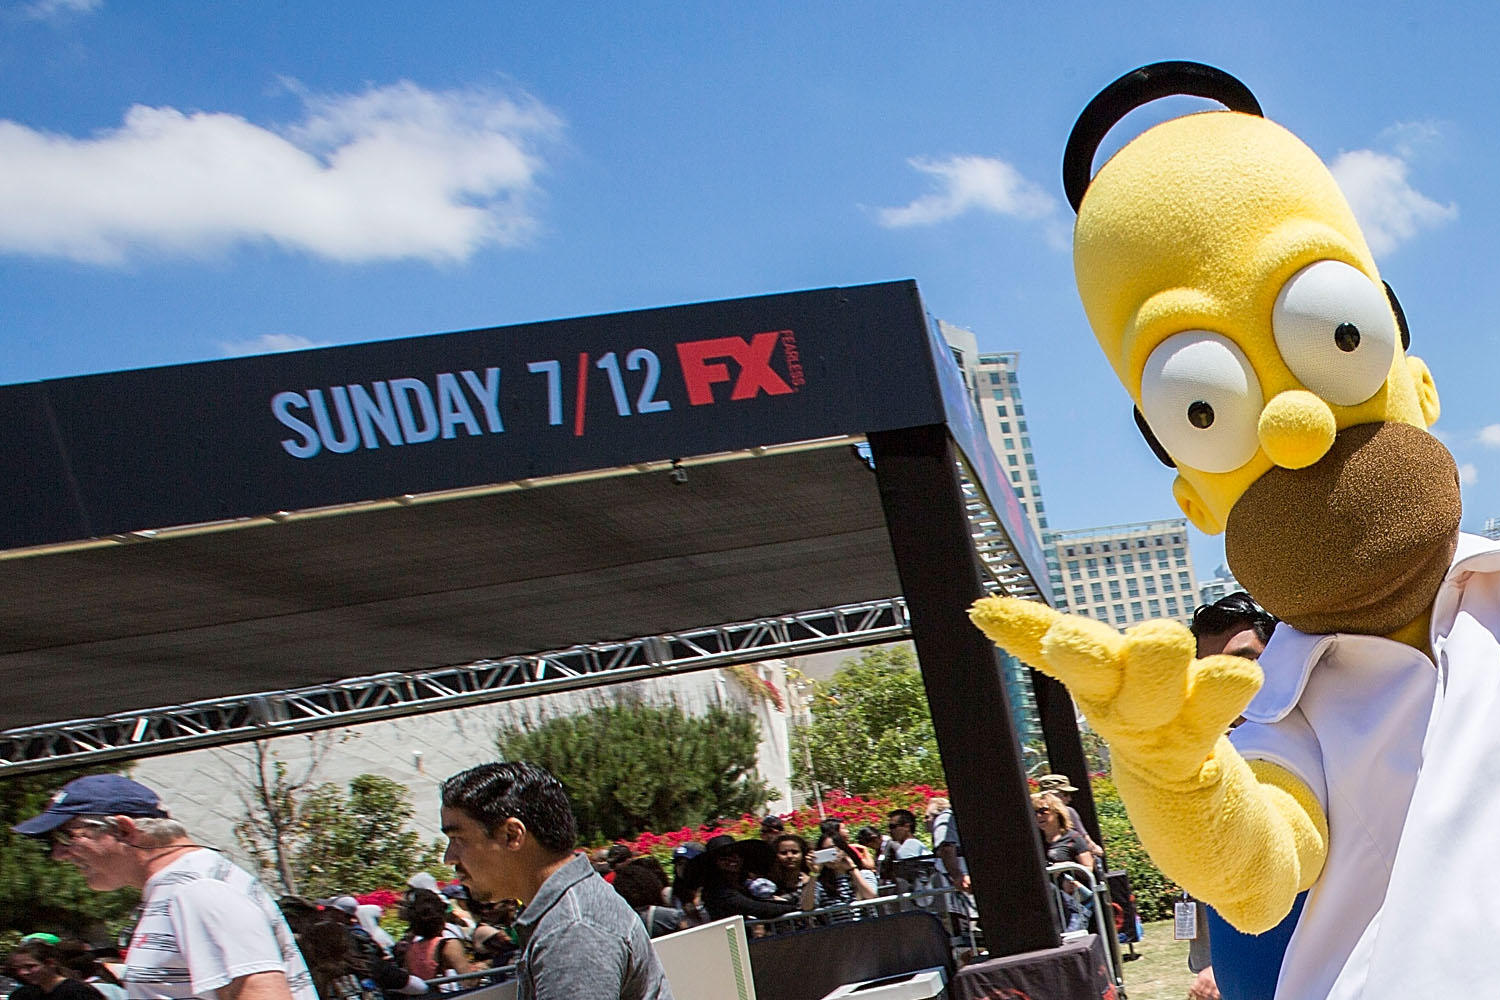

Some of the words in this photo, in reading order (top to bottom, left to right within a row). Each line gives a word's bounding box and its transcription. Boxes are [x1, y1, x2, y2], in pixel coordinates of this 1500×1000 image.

[271, 367, 505, 459] SUNDAY
[527, 348, 672, 437] 7/12
[675, 331, 793, 406] FX
